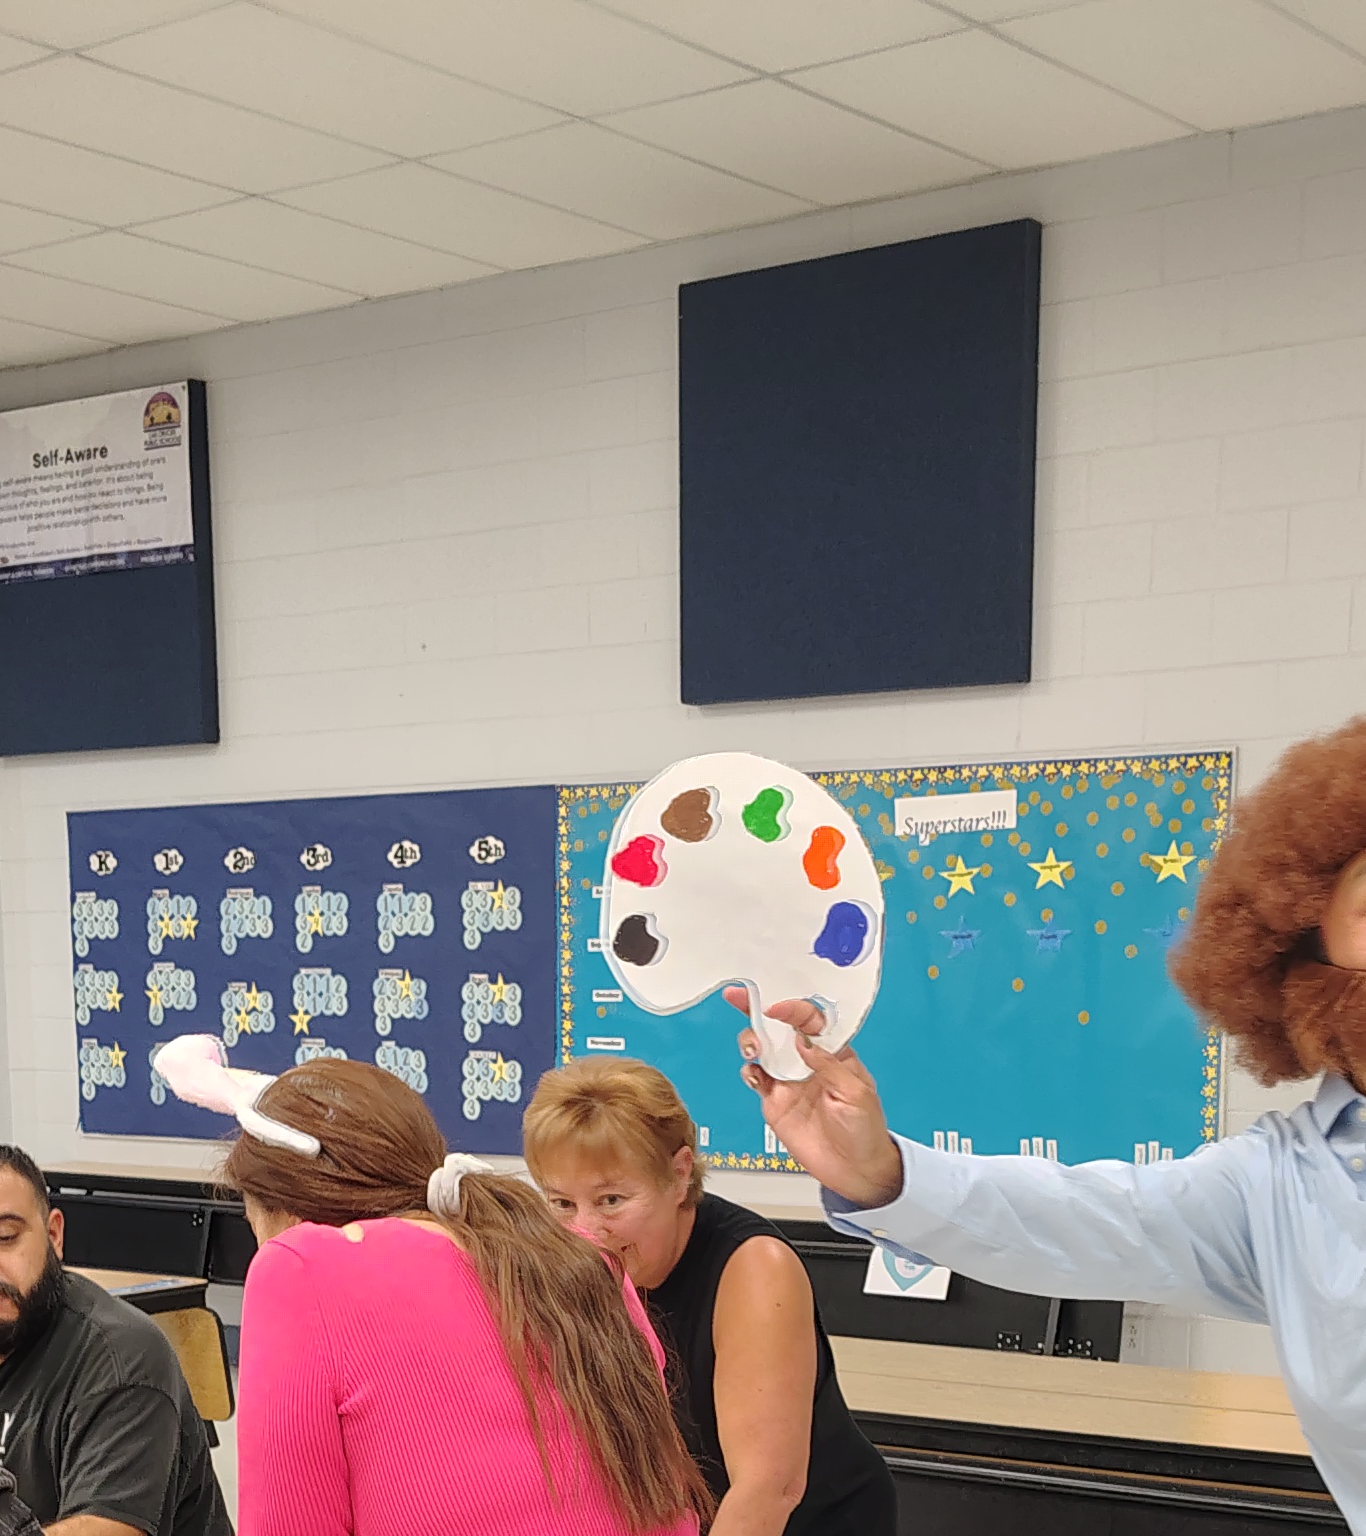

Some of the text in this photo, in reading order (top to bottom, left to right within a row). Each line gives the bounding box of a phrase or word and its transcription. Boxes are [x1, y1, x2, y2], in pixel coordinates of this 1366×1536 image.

[32, 445, 108, 469] Self-Aware
[903, 810, 1007, 844] Superstars!!!
[306, 848, 329, 867] 3rd
[393, 844, 417, 864] 4th
[478, 840, 502, 861] 5th
[97, 854, 110, 872] K
[162, 853, 179, 871] 1st
[151, 900, 157, 915] 2
[177, 899, 180, 914] 1
[225, 899, 266, 915] 2 3 2 1
[302, 897, 306, 913] 1
[327, 896, 331, 911] 1
[337, 896, 343, 911] 2
[384, 896, 427, 913] 1 1 2 3
[466, 892, 473, 908] 3
[480, 892, 487, 908] 3
[508, 890, 516, 906] 3
[152, 918, 158, 934] 3
[225, 918, 268, 934] 2 2 3 3
[301, 918, 307, 930] 3
[325, 915, 332, 931] 2
[336, 915, 343, 931] 3
[383, 916, 428, 932] 2 3 2 2
[467, 910, 517, 928] 3 3 3 3
[152, 936, 159, 951] 3
[225, 936, 233, 950] 3
[301, 934, 307, 948] 2
[383, 934, 390, 949] 3
[468, 931, 476, 945] 3
[164, 972, 171, 986] 3
[175, 972, 181, 986] 3
[184, 973, 191, 987] 3
[298, 976, 341, 993] 3 1 1 2
[378, 980, 385, 995] 2
[390, 980, 397, 996] 3
[414, 980, 422, 996] 3
[467, 984, 475, 1000] 3
[481, 985, 490, 1000] 3
[509, 987, 517, 1002] 3
[164, 989, 170, 1004] 3
[176, 991, 181, 1005] 2
[186, 991, 192, 1005] 2
[226, 993, 233, 1007] 3
[262, 994, 269, 1008] 3
[312, 996, 317, 1013] 1
[325, 995, 331, 1010] 2
[336, 996, 343, 1012] 3
[153, 1006, 159, 1021] 2
[379, 998, 424, 1015] 3 3 3 3
[467, 1003, 517, 1021] 3 3 3 3
[227, 1011, 233, 1026] 2
[253, 1014, 260, 1028] 3
[264, 1013, 271, 1028] 3
[380, 1016, 387, 1031] 3
[227, 1029, 234, 1043] 3
[468, 1024, 476, 1038] 3
[467, 1060, 517, 1079] 3 3 3
[467, 1080, 516, 1098] 3 3 3 3
[468, 1100, 475, 1116] 3
